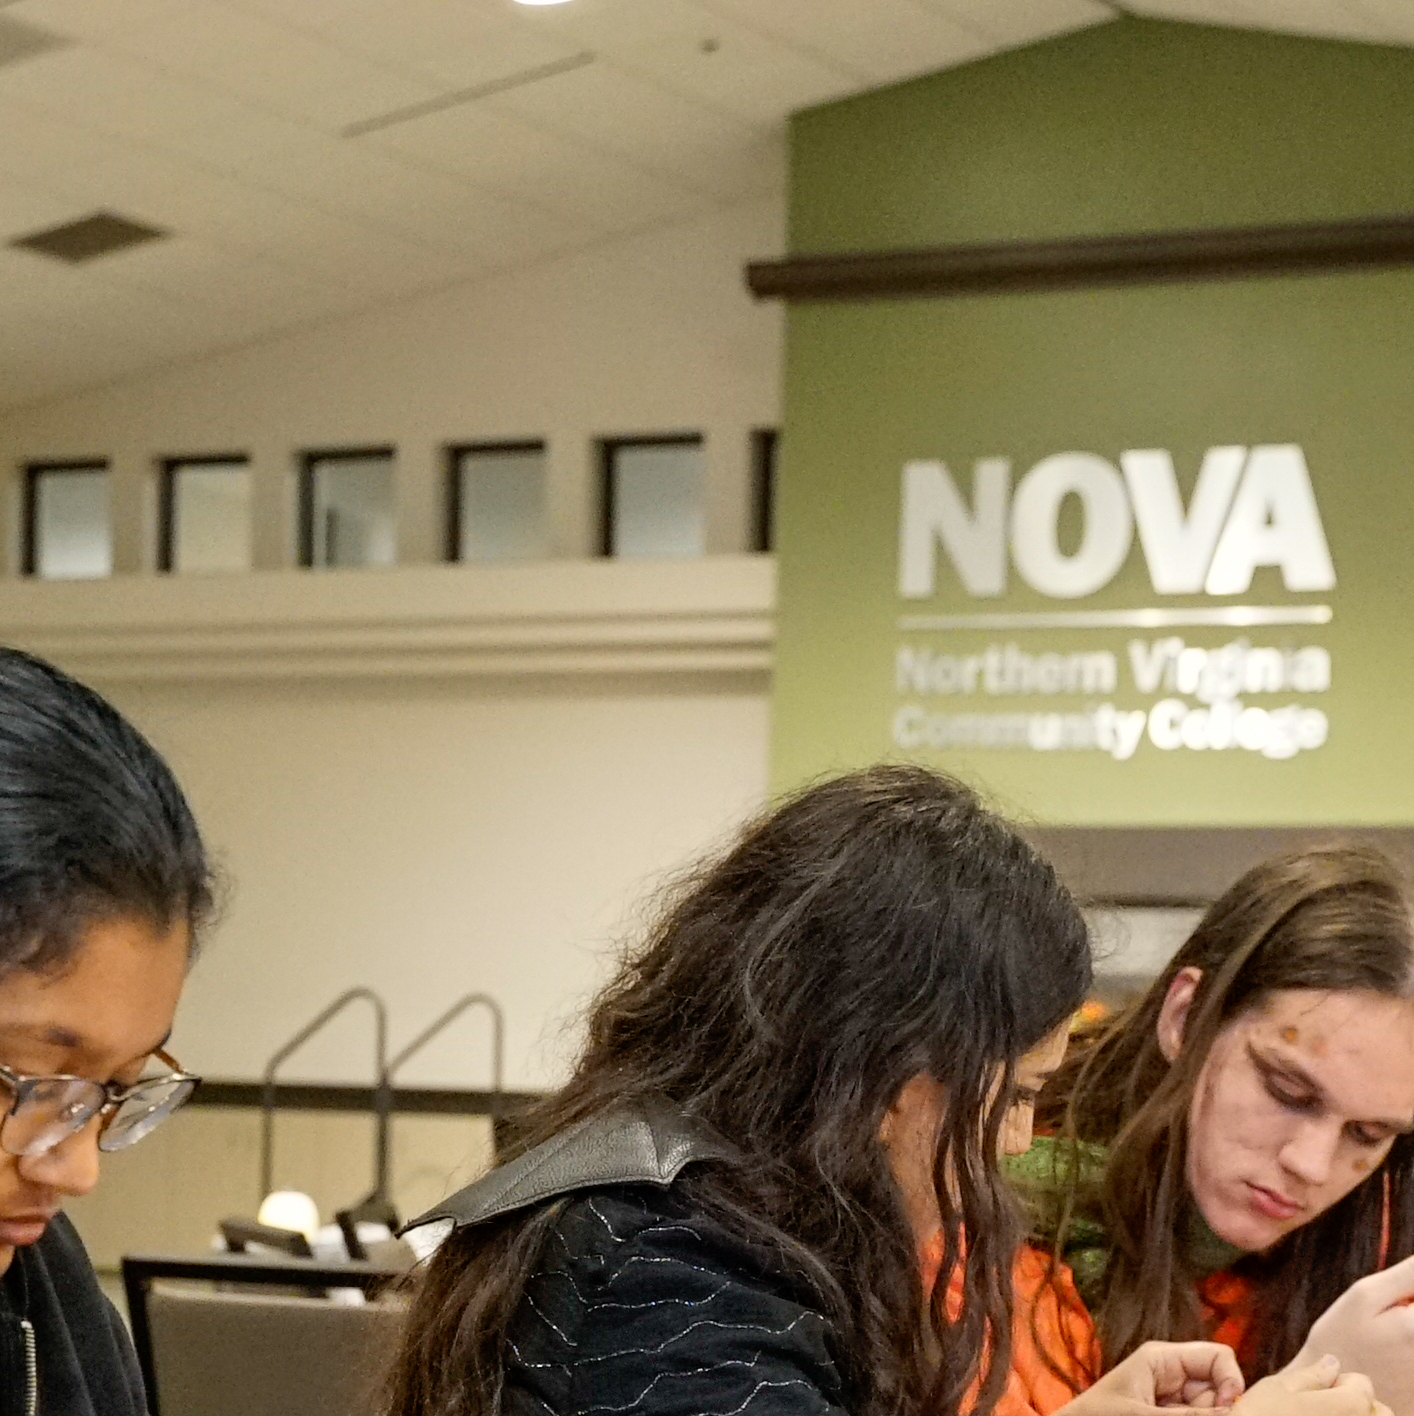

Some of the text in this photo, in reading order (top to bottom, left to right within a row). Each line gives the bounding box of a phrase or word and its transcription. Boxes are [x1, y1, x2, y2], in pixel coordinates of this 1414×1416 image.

[898, 443, 1335, 598] NOVA
[895, 636, 1331, 702] Northern Virginia
[894, 699, 1328, 759] Community College
